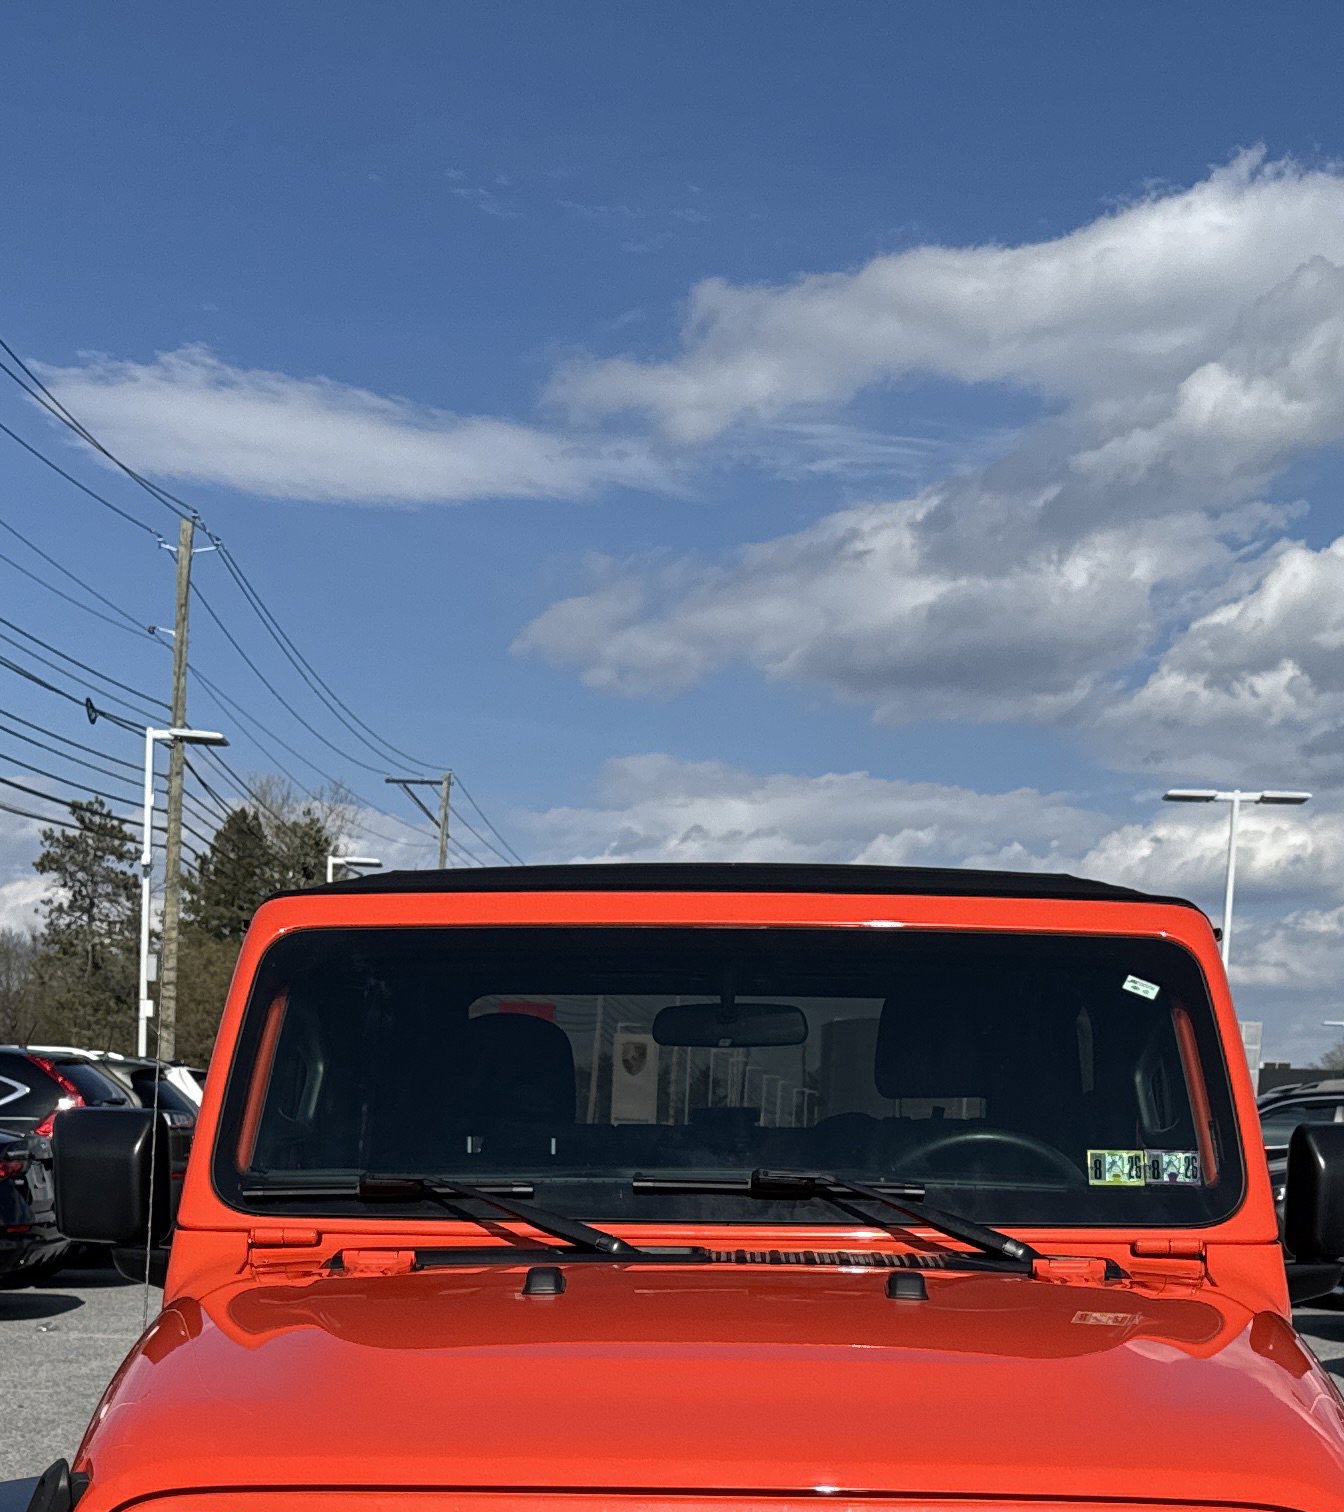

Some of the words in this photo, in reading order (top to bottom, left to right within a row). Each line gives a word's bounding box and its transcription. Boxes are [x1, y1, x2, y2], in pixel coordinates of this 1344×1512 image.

[1094, 1158, 1102, 1180] 8
[1152, 1159, 1160, 1180] 8
[1184, 1155, 1198, 1179] 26
